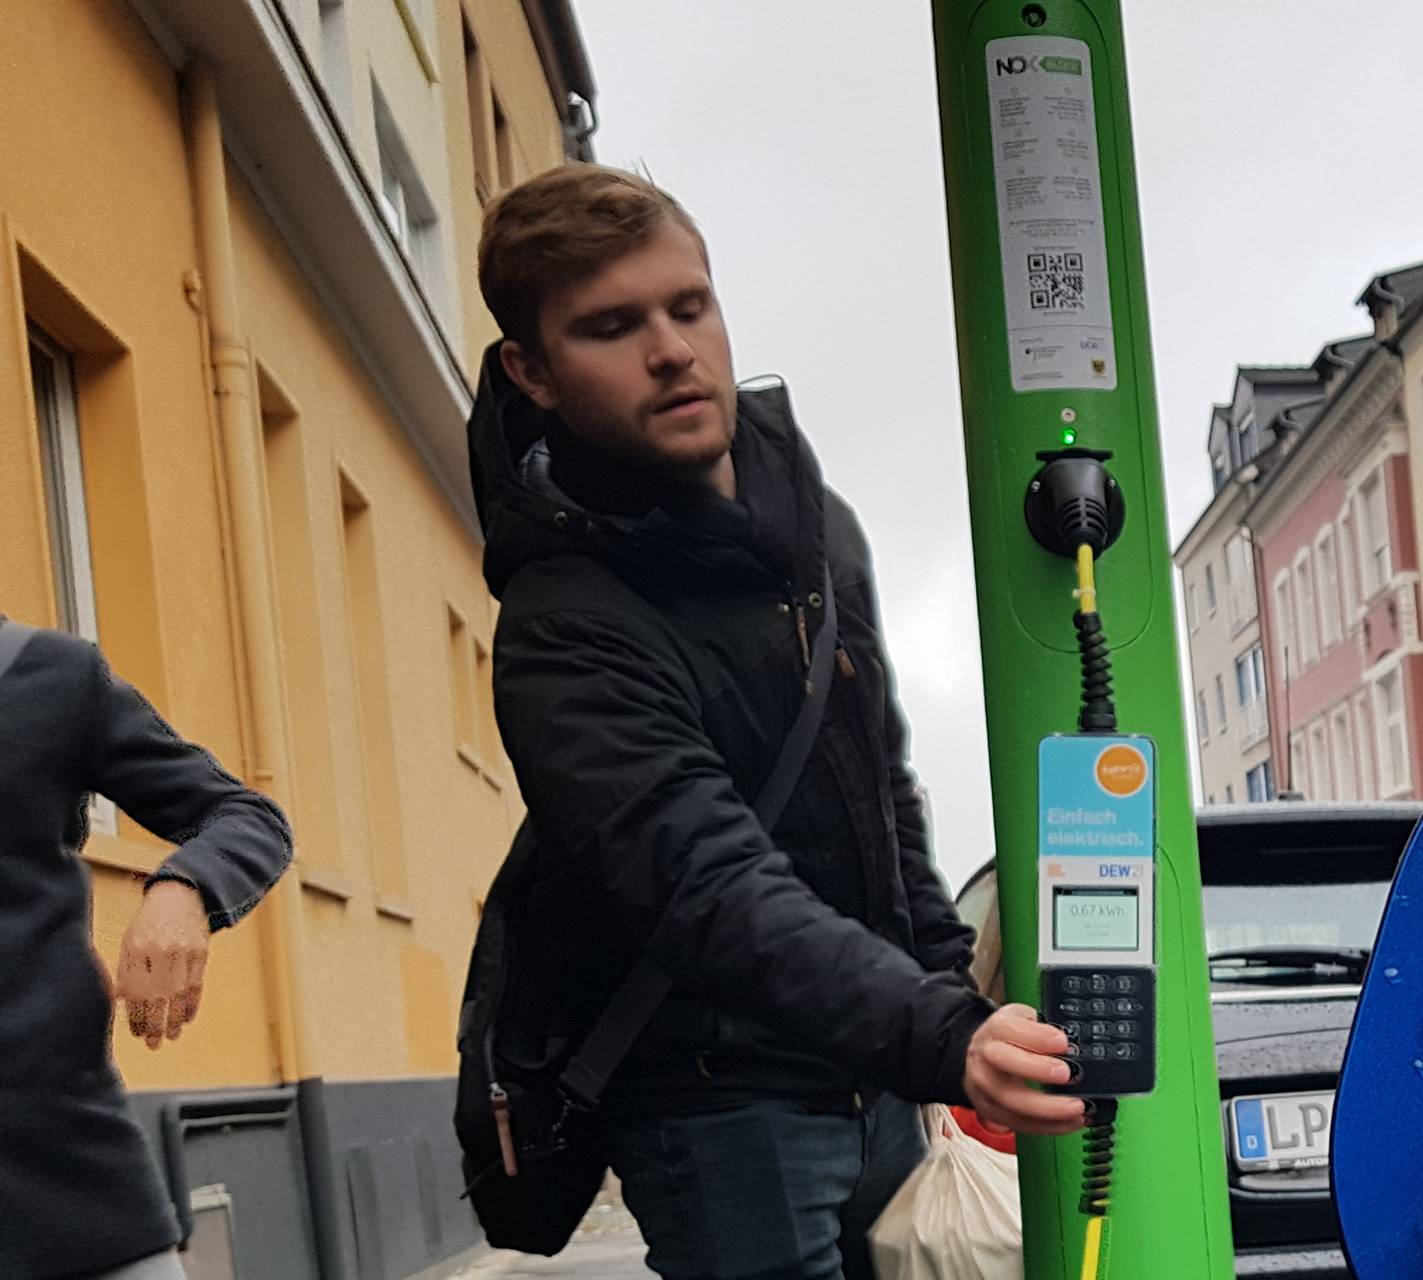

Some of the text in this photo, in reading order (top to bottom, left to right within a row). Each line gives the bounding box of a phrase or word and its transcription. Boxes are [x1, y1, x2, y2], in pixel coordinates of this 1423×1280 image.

[1047, 808, 1116, 825] Einfach
[1047, 829, 1144, 846] elektrisch.
[1100, 904, 1125, 917] kWh
[1266, 1102, 1329, 1150] LP
[1247, 1135, 1258, 1149] D
